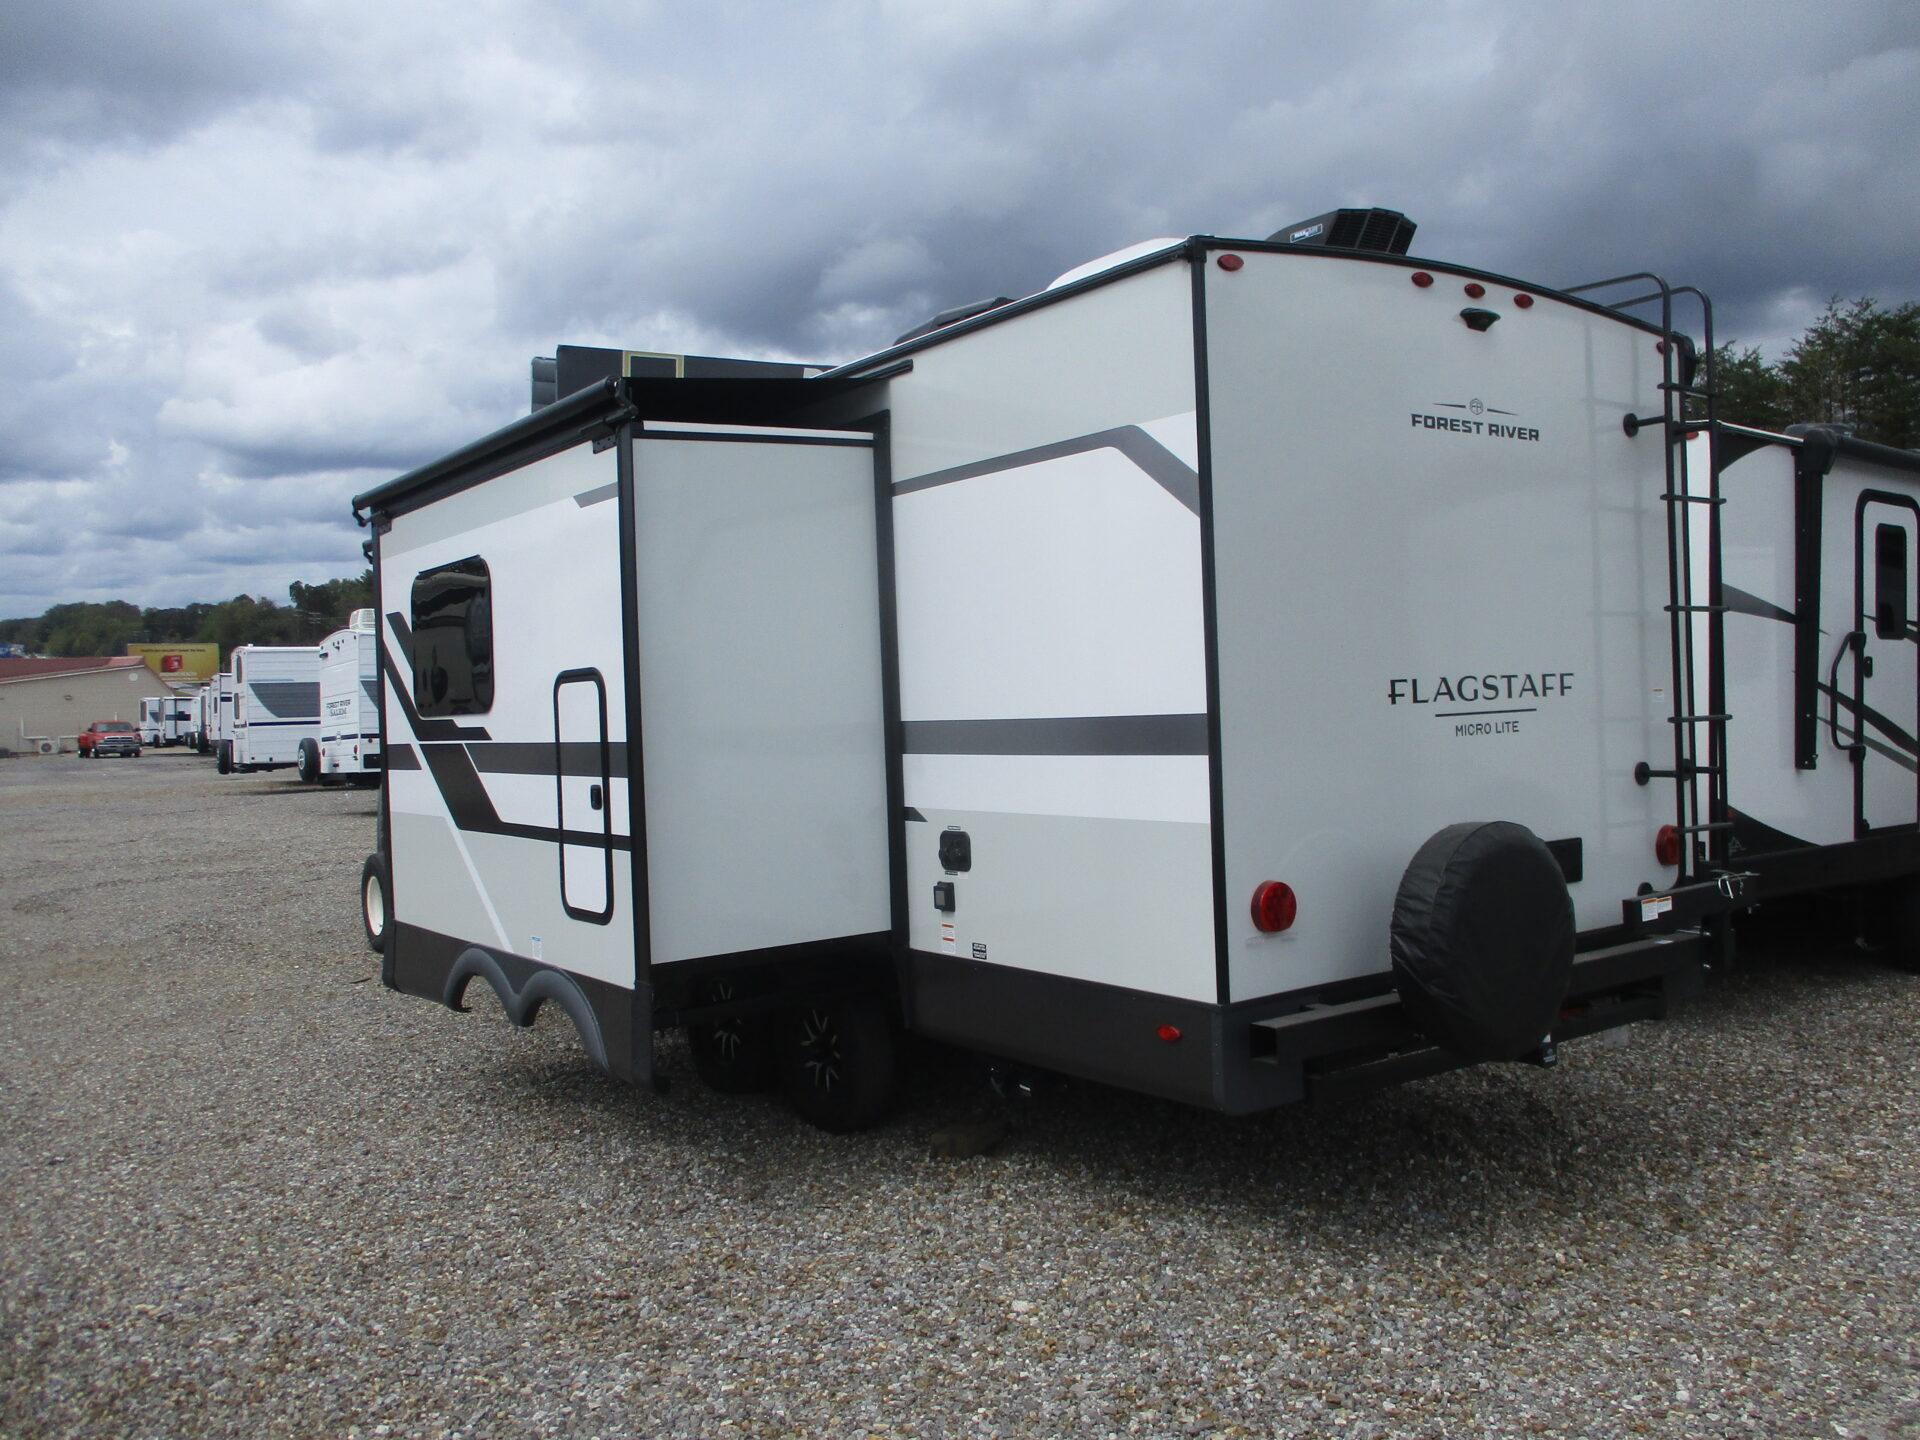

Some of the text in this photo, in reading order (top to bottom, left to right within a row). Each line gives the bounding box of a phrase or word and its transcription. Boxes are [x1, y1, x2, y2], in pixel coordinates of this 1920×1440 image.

[1411, 413, 1540, 441] FOREST RIVER
[1388, 673, 1575, 705] FLAGSTAFF
[1455, 721, 1519, 737] MICRO LITE
